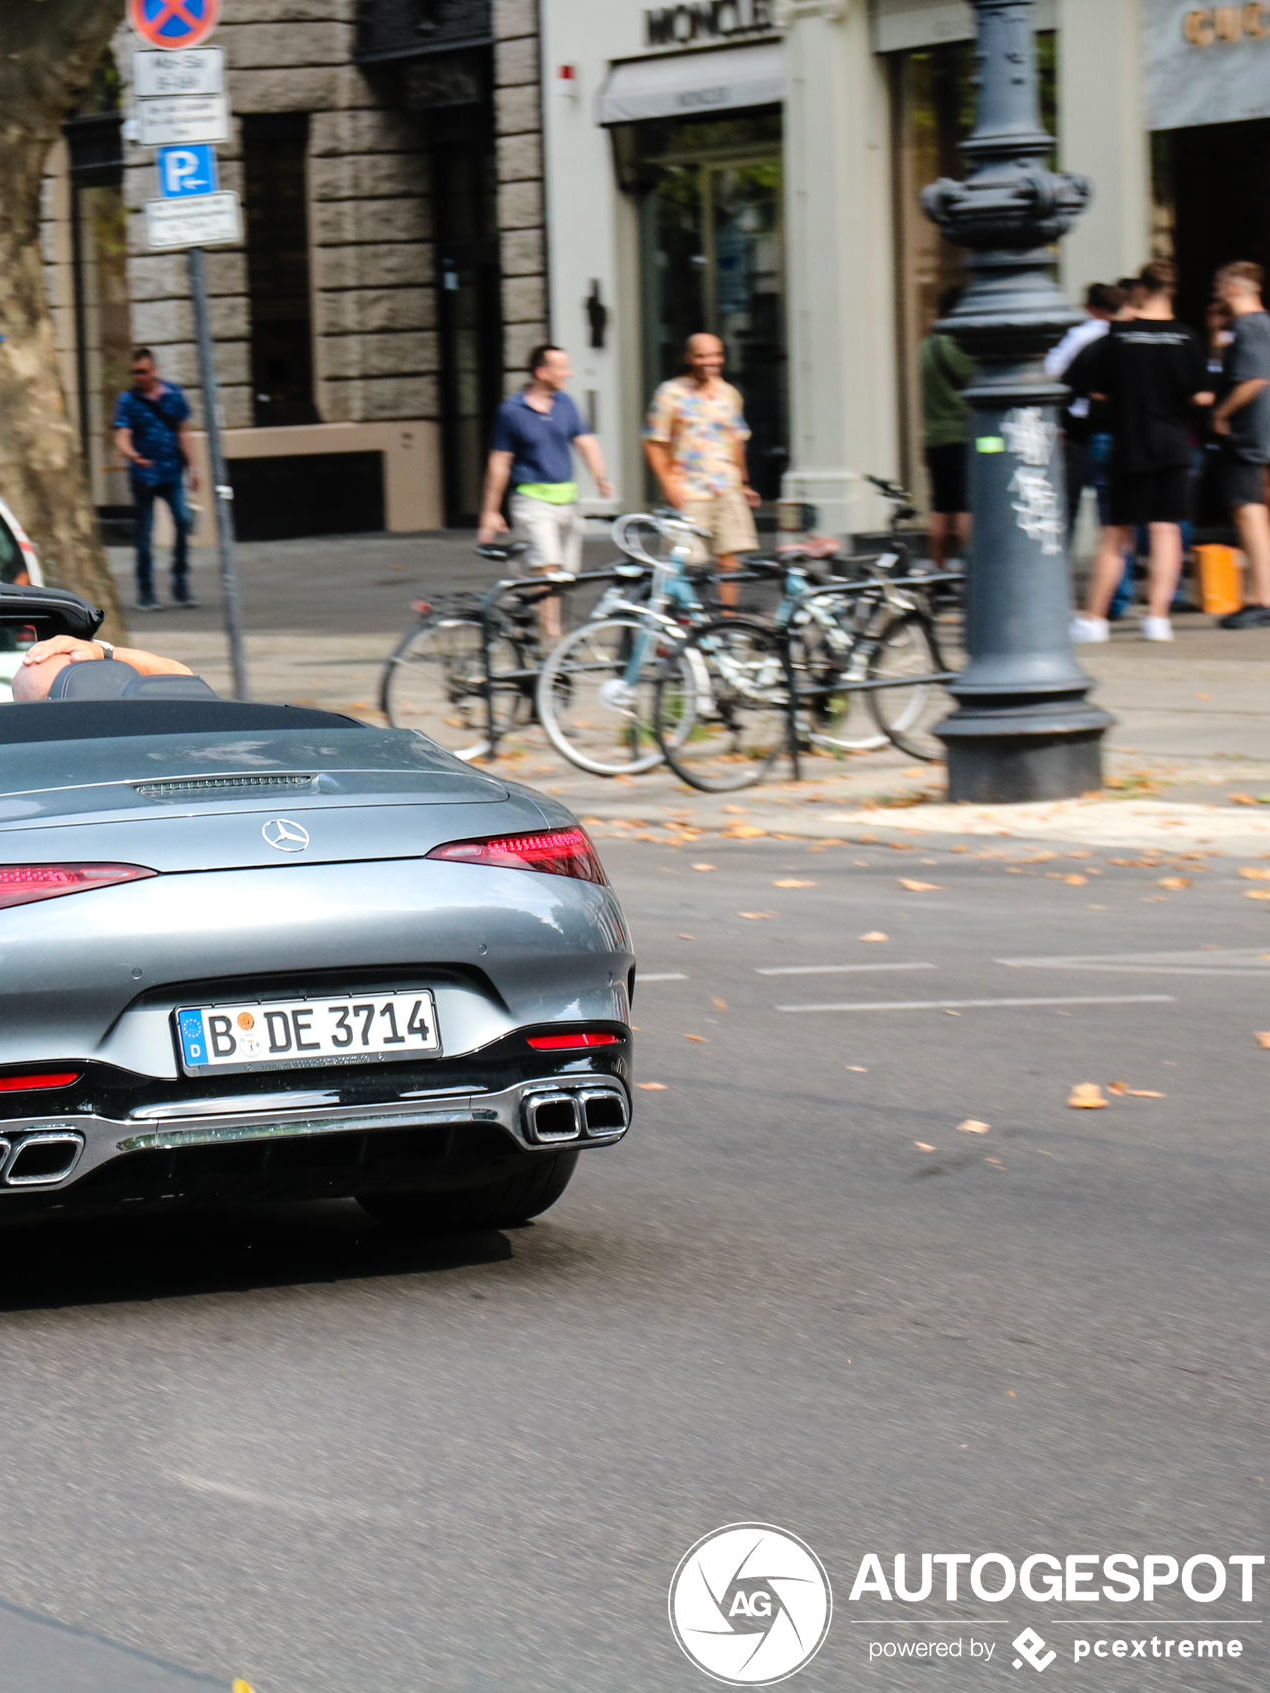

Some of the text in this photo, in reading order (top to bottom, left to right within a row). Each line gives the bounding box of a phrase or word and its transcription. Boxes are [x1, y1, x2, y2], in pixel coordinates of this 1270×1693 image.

[165, 150, 199, 192] P
[208, 1000, 430, 1058] B DE 3714
[190, 1044, 201, 1057] D
